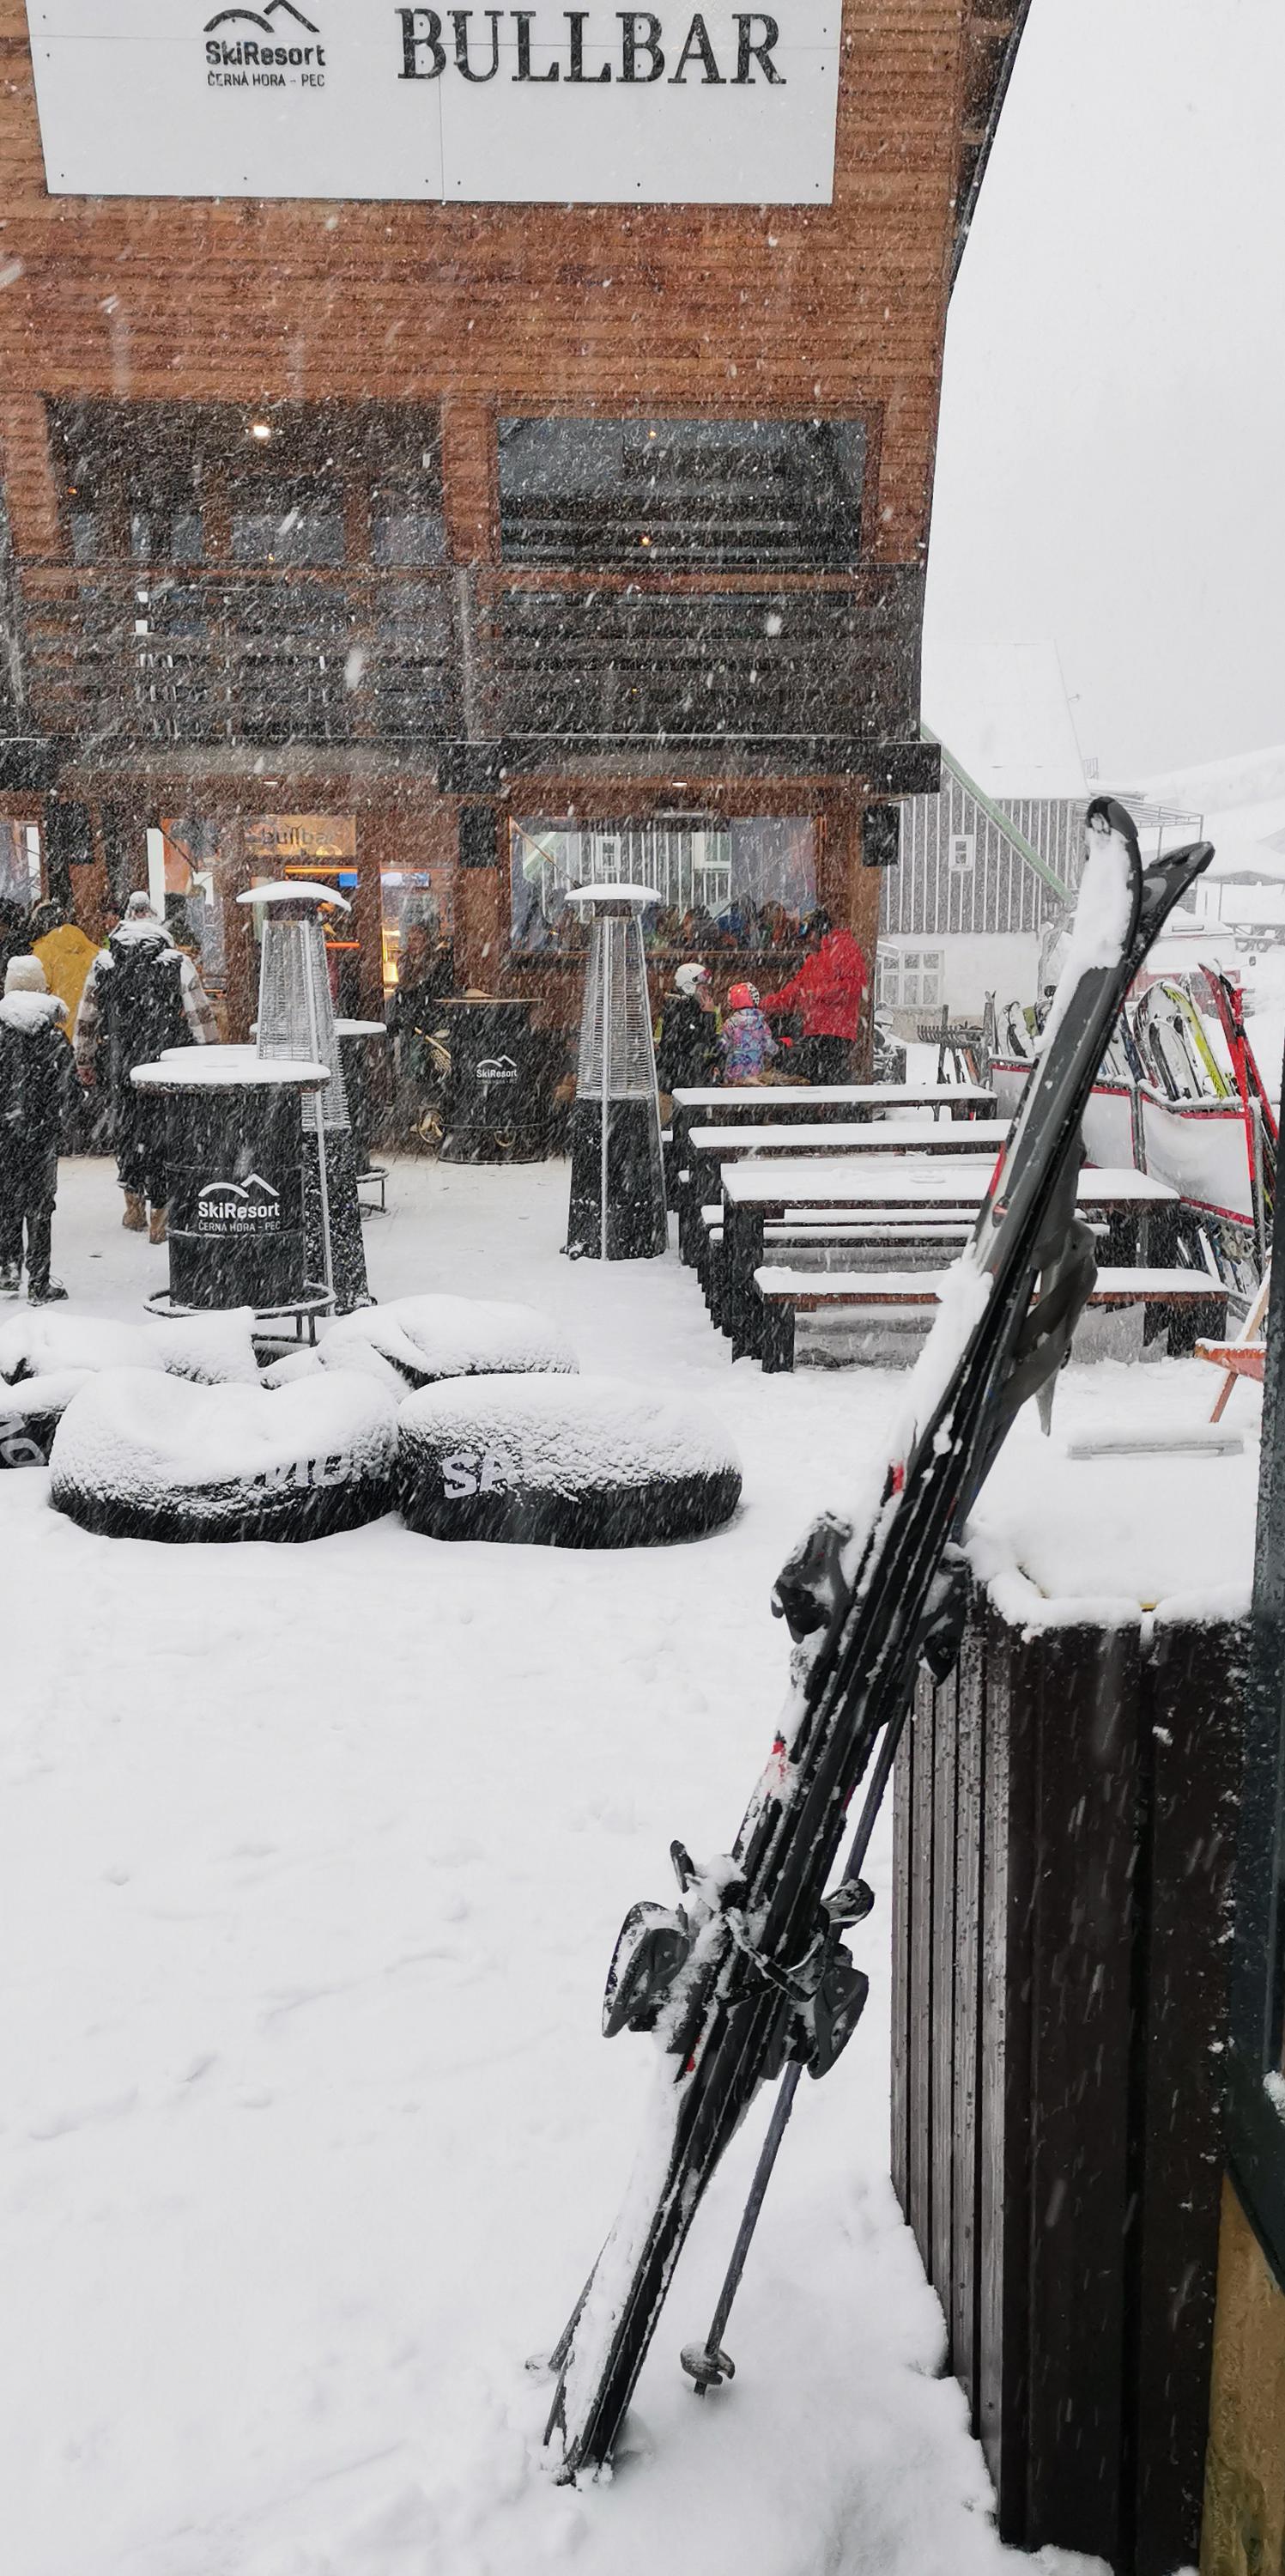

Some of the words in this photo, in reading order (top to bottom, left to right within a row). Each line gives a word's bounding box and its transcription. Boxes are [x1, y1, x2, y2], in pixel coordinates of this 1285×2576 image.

[205, 40, 326, 66] SkiResort
[394, 8, 786, 84] BULLBAR
[207, 70, 249, 87] ČERNÁ
[252, 74, 287, 87] HORA
[301, 74, 325, 87] PEC
[476, 1068, 518, 1078] SkiResort
[198, 1201, 280, 1218] SkiResort
[229, 1222, 256, 1232] HORA
[264, 1220, 281, 1231] PEC
